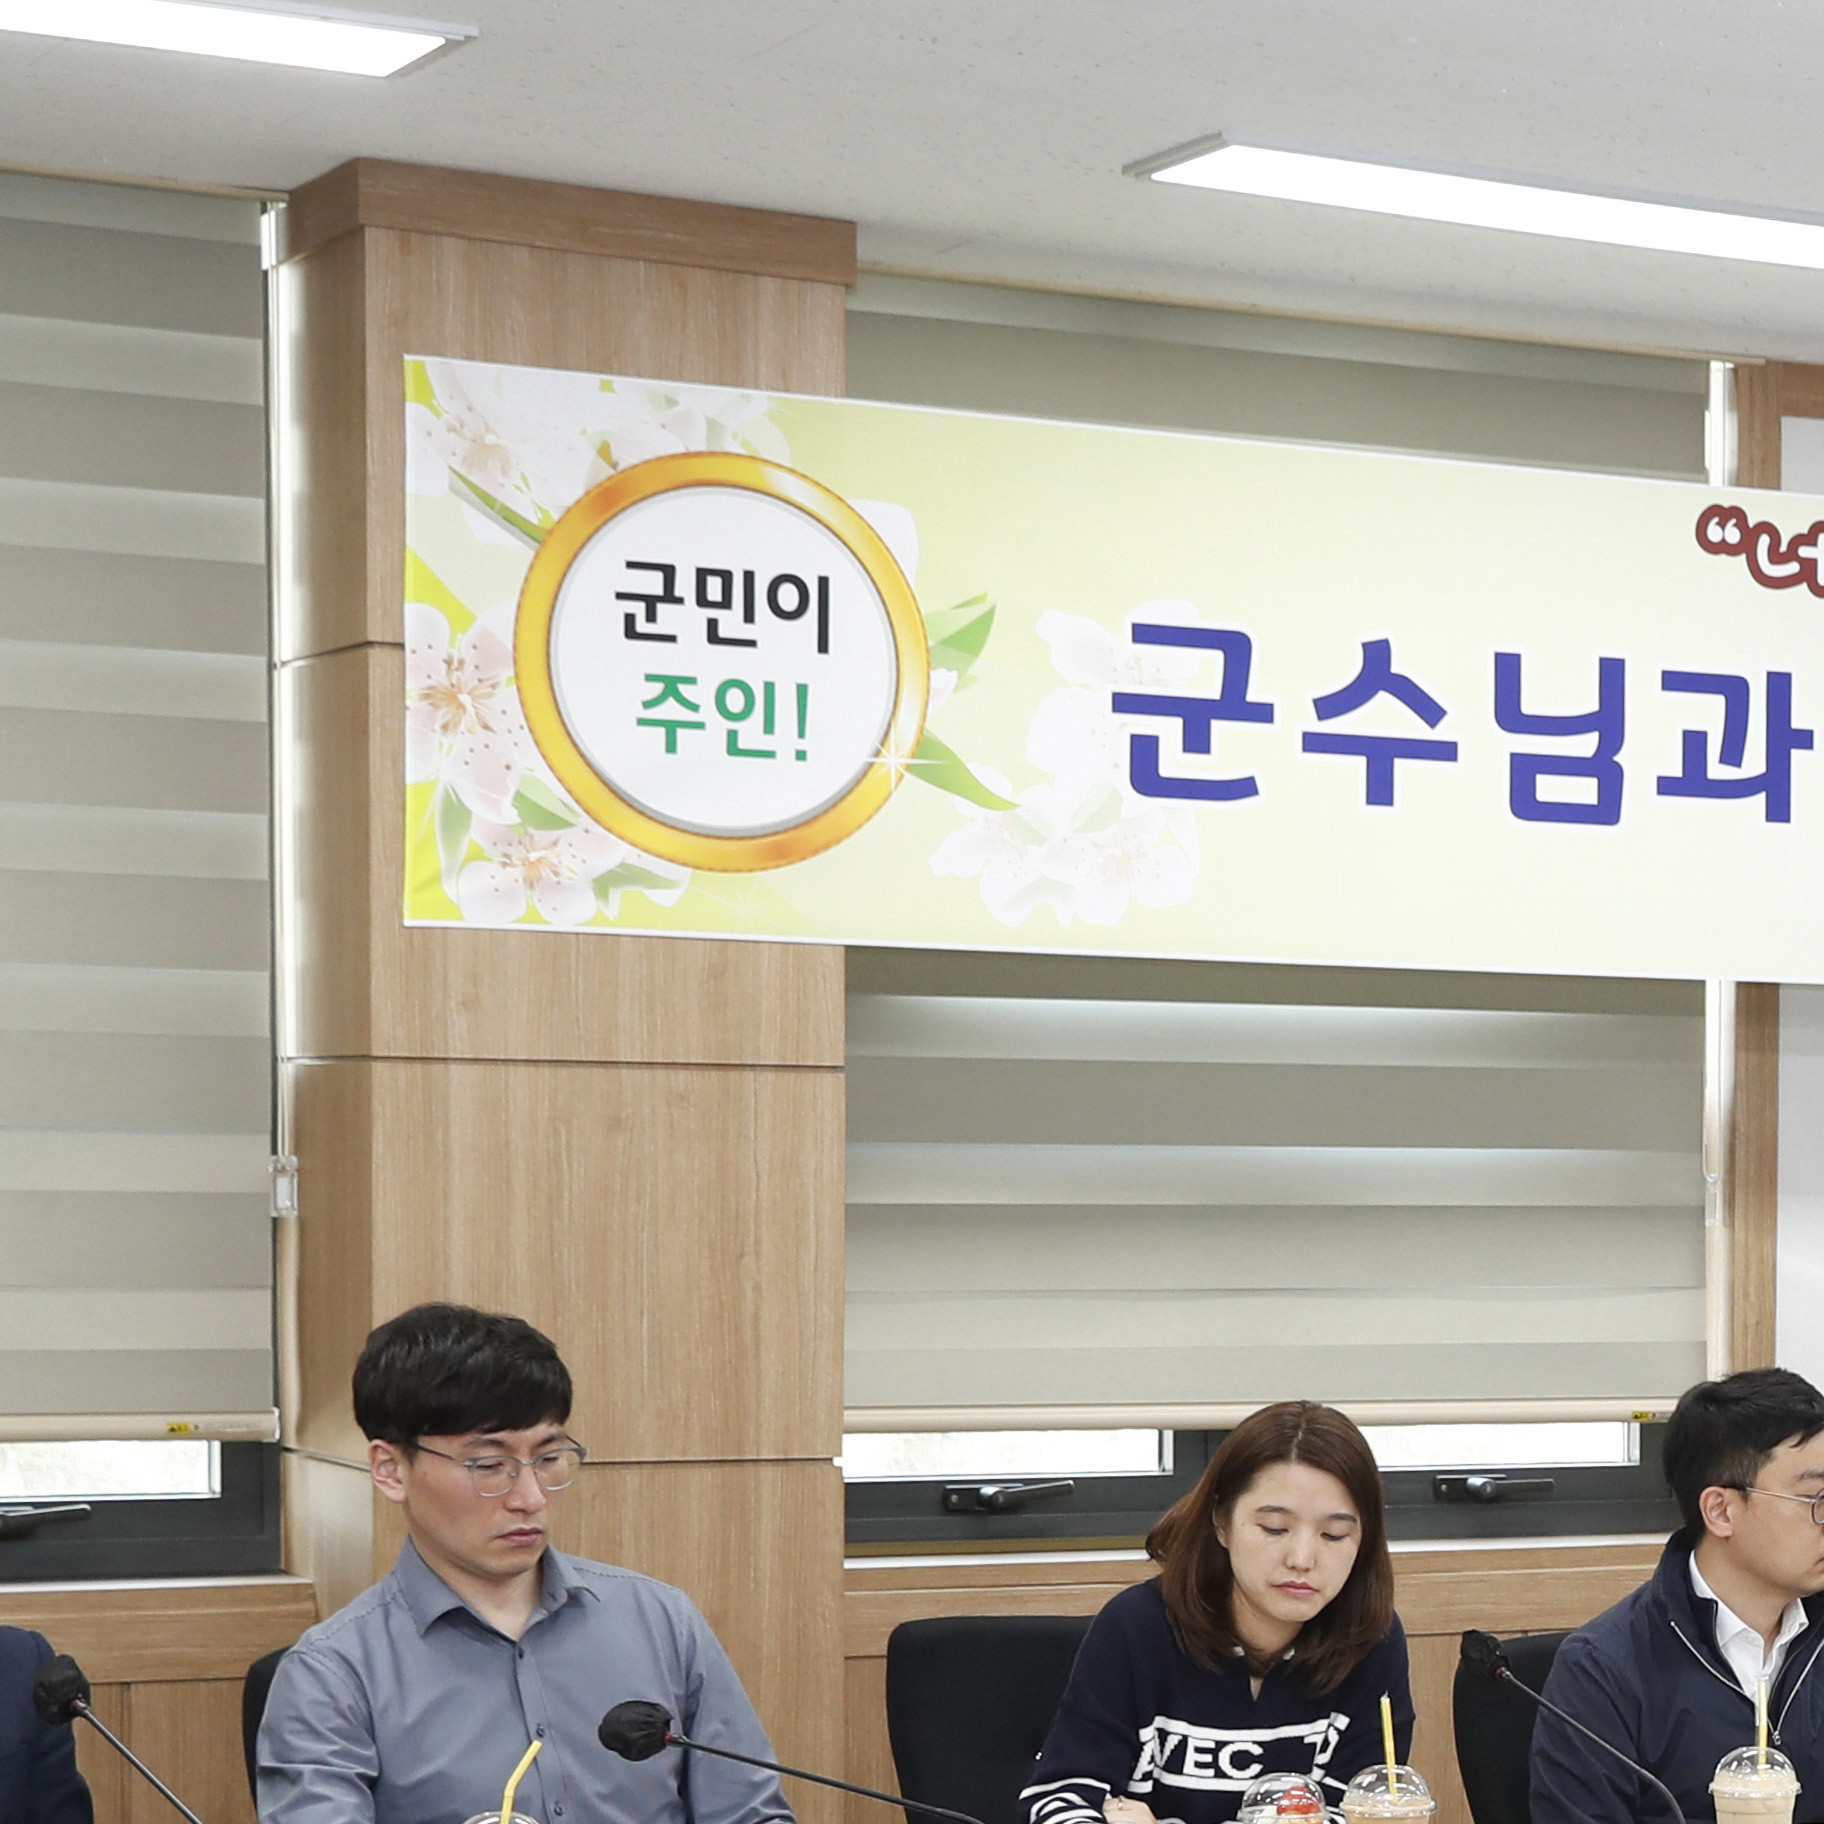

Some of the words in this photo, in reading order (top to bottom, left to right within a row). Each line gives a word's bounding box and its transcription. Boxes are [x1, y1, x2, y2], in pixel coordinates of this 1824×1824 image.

[613, 558, 833, 655] 군민이
[633, 671, 811, 763] 주인!
[1109, 620, 1816, 827] 군수님과
[1131, 1732, 1266, 1781] AVEC
